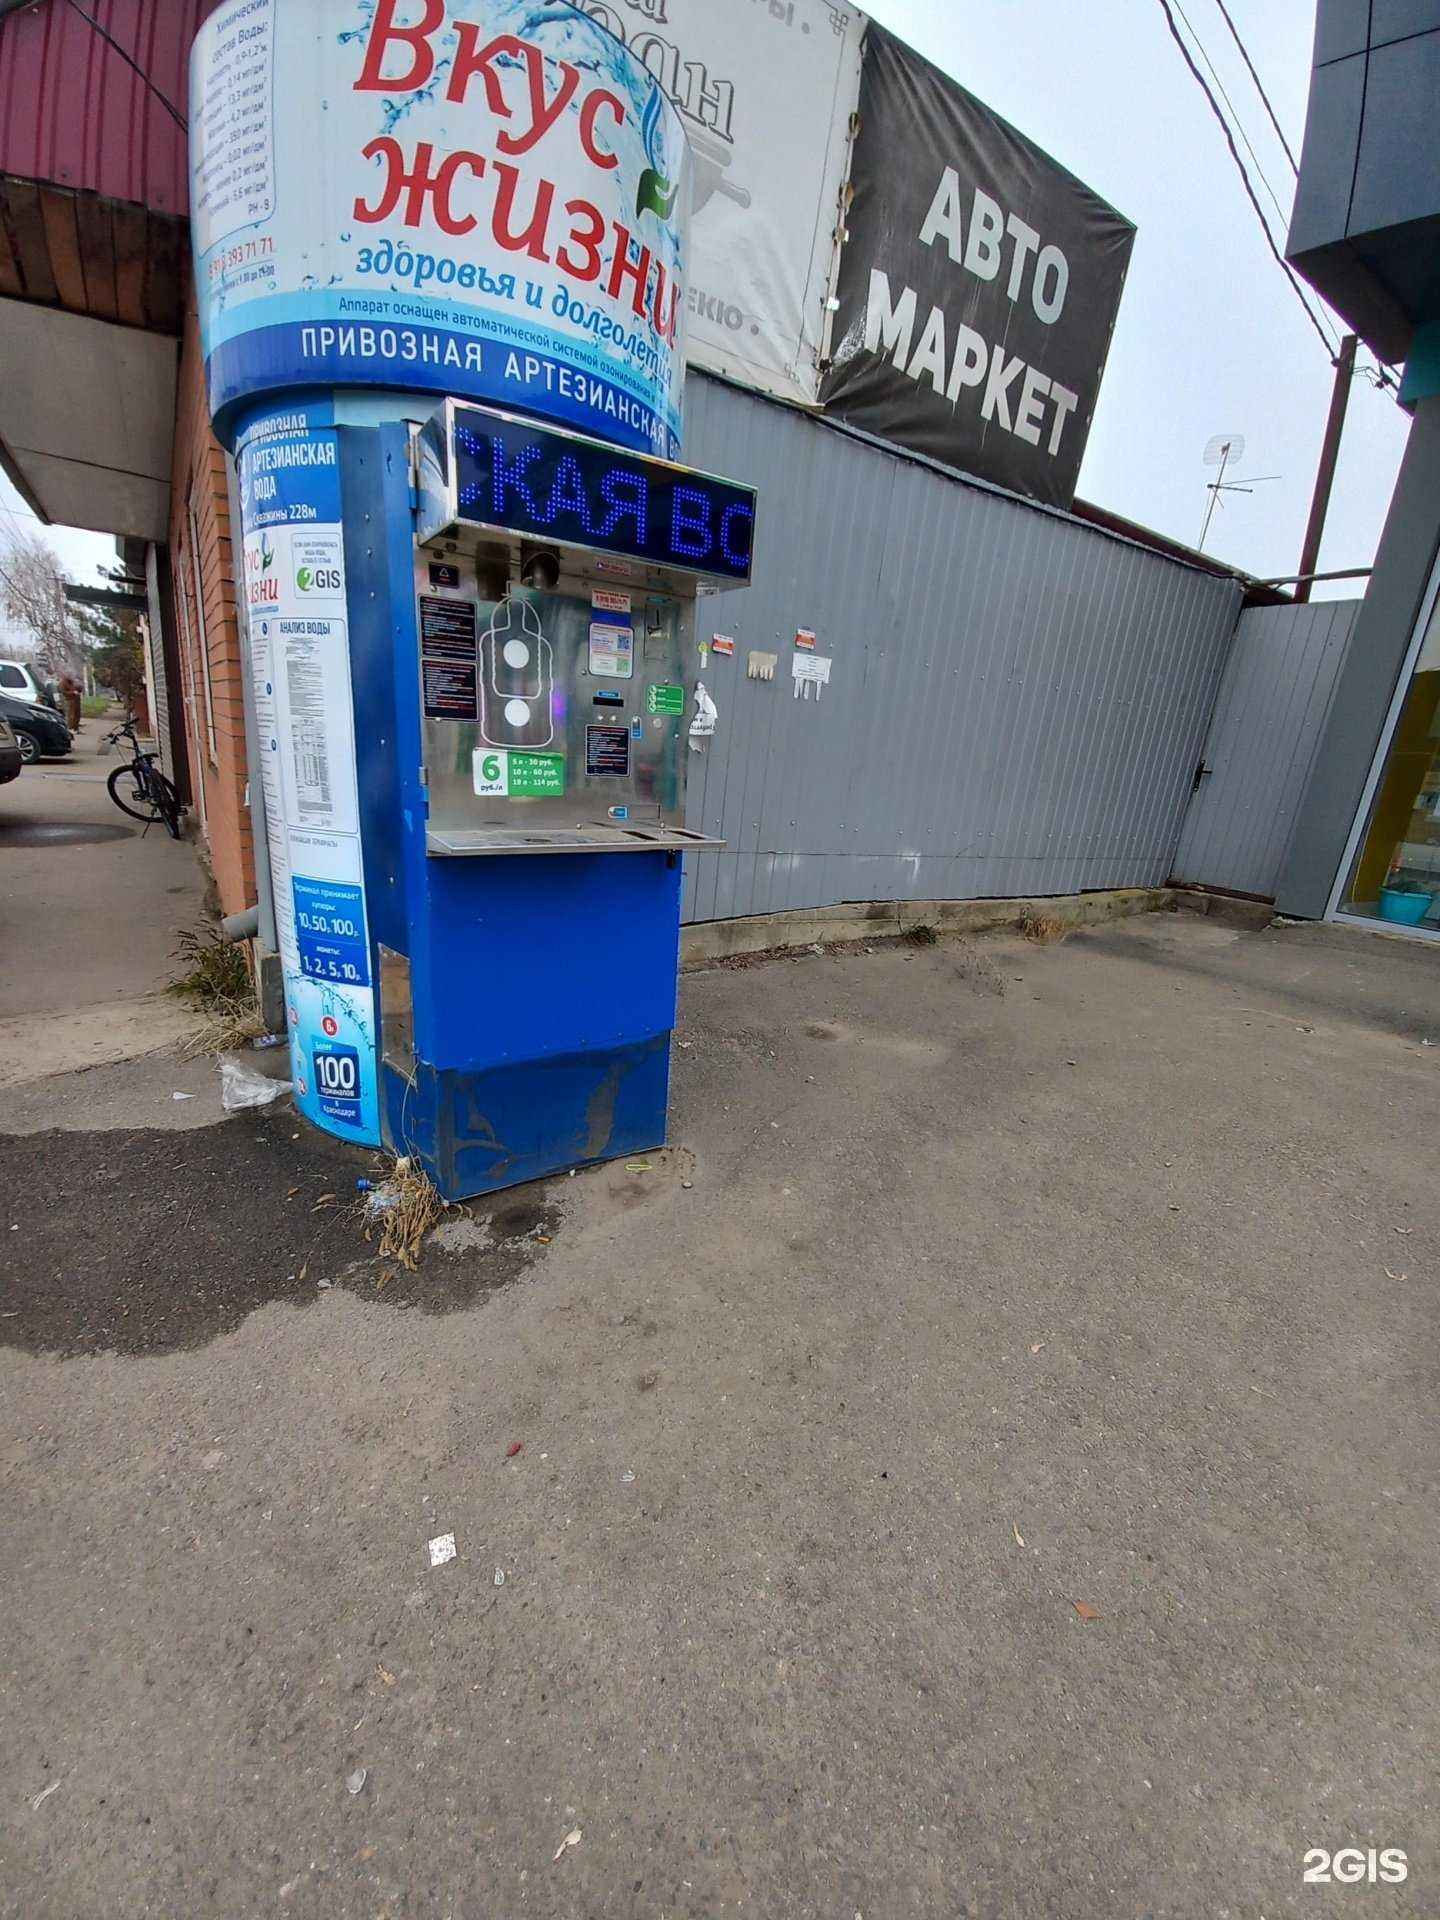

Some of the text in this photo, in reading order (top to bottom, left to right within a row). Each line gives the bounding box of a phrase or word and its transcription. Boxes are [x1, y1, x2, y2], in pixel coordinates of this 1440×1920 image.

[352, 0, 625, 170] Вкус
[260, 236, 274, 255] 71
[352, 136, 681, 350] жизни
[917, 165, 1070, 325] АВТО
[356, 238, 516, 300] здоровья
[525, 280, 544, 310] и
[338, 296, 391, 315] Аппарат
[393, 302, 450, 323] оснащен
[451, 311, 550, 350] автоматической
[552, 339, 600, 371] системой
[301, 326, 483, 373] ПРИВОЗНАЯ
[504, 351, 667, 448] АРТЕЗИАНСКАЯ
[864, 267, 1079, 457] МАРКЕТ
[252, 442, 336, 474] АРТЕЗИАНСКАЯ
[253, 475, 277, 500] ВОДА
[289, 504, 317, 520] 228м
[280, 621, 331, 636] АНАЛИЗ ВОДЫ
[482, 755, 501, 782] 6
[316, 1055, 355, 1089] 100
